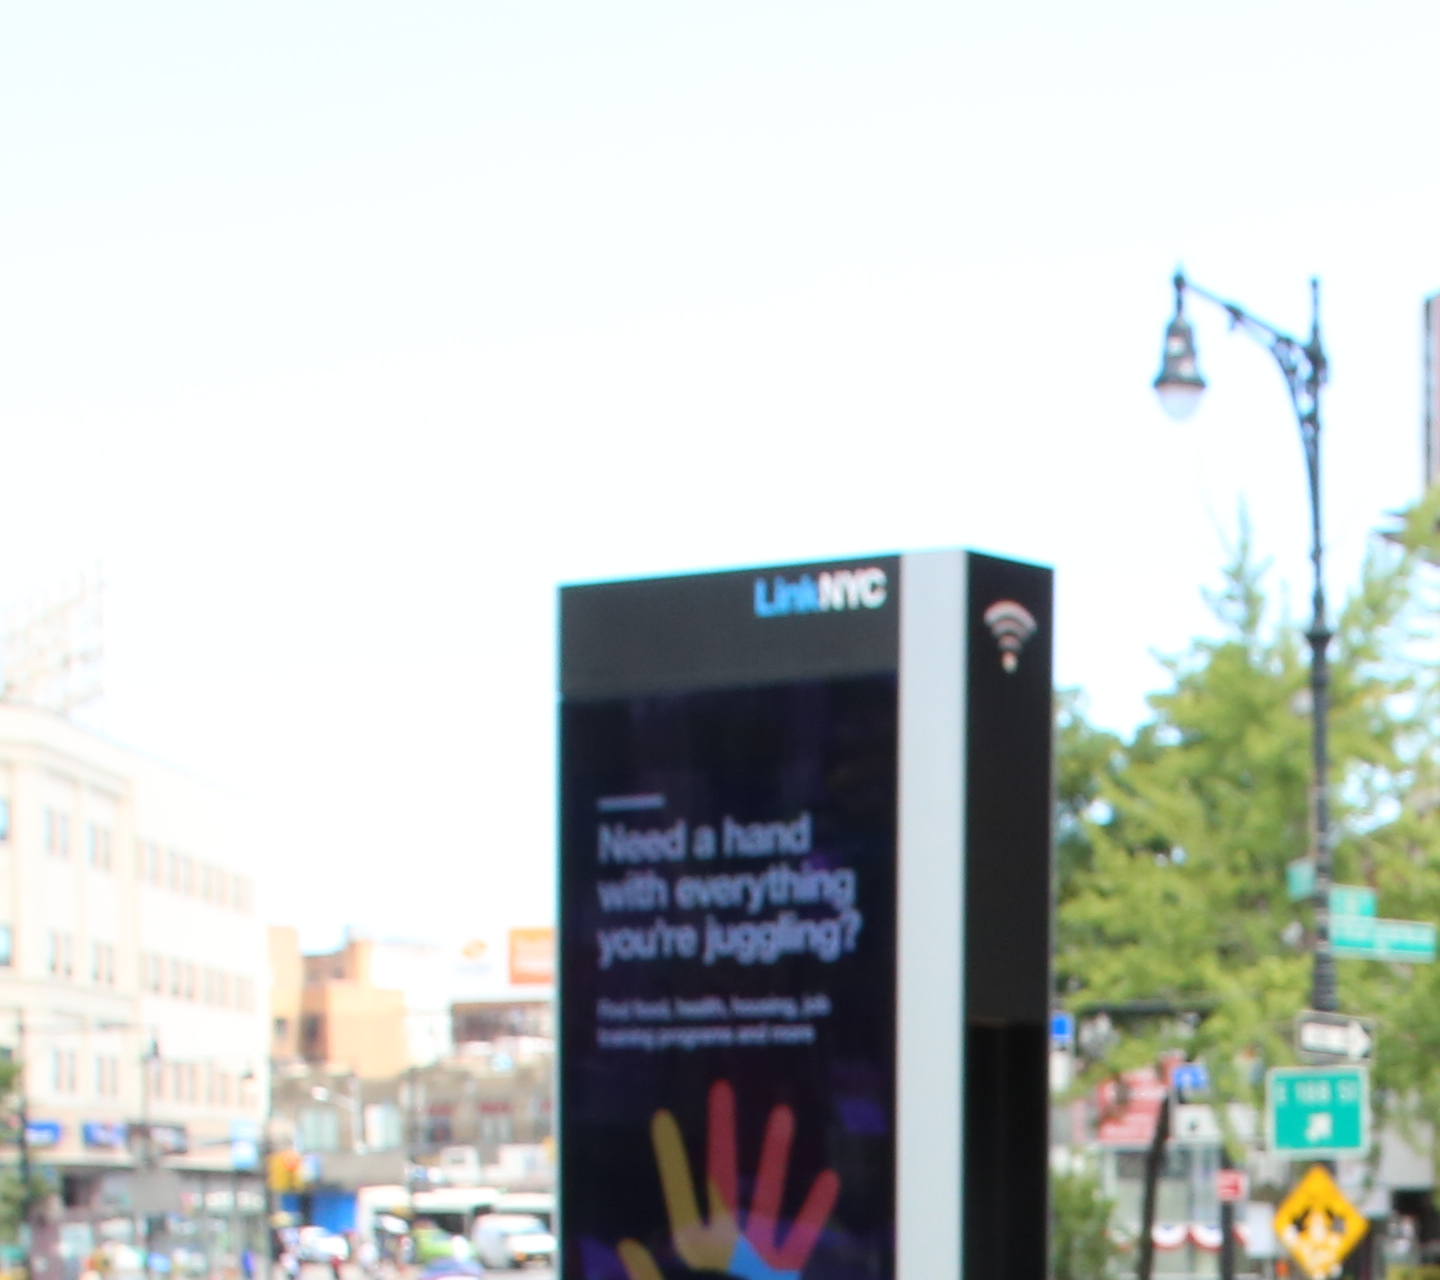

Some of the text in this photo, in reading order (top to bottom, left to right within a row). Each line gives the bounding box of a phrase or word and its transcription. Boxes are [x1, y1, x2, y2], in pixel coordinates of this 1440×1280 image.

[753, 567, 888, 619] LinkNYC
[598, 810, 813, 864] Need a hand
[597, 859, 857, 914] with everything
[702, 907, 864, 966] juggling?
